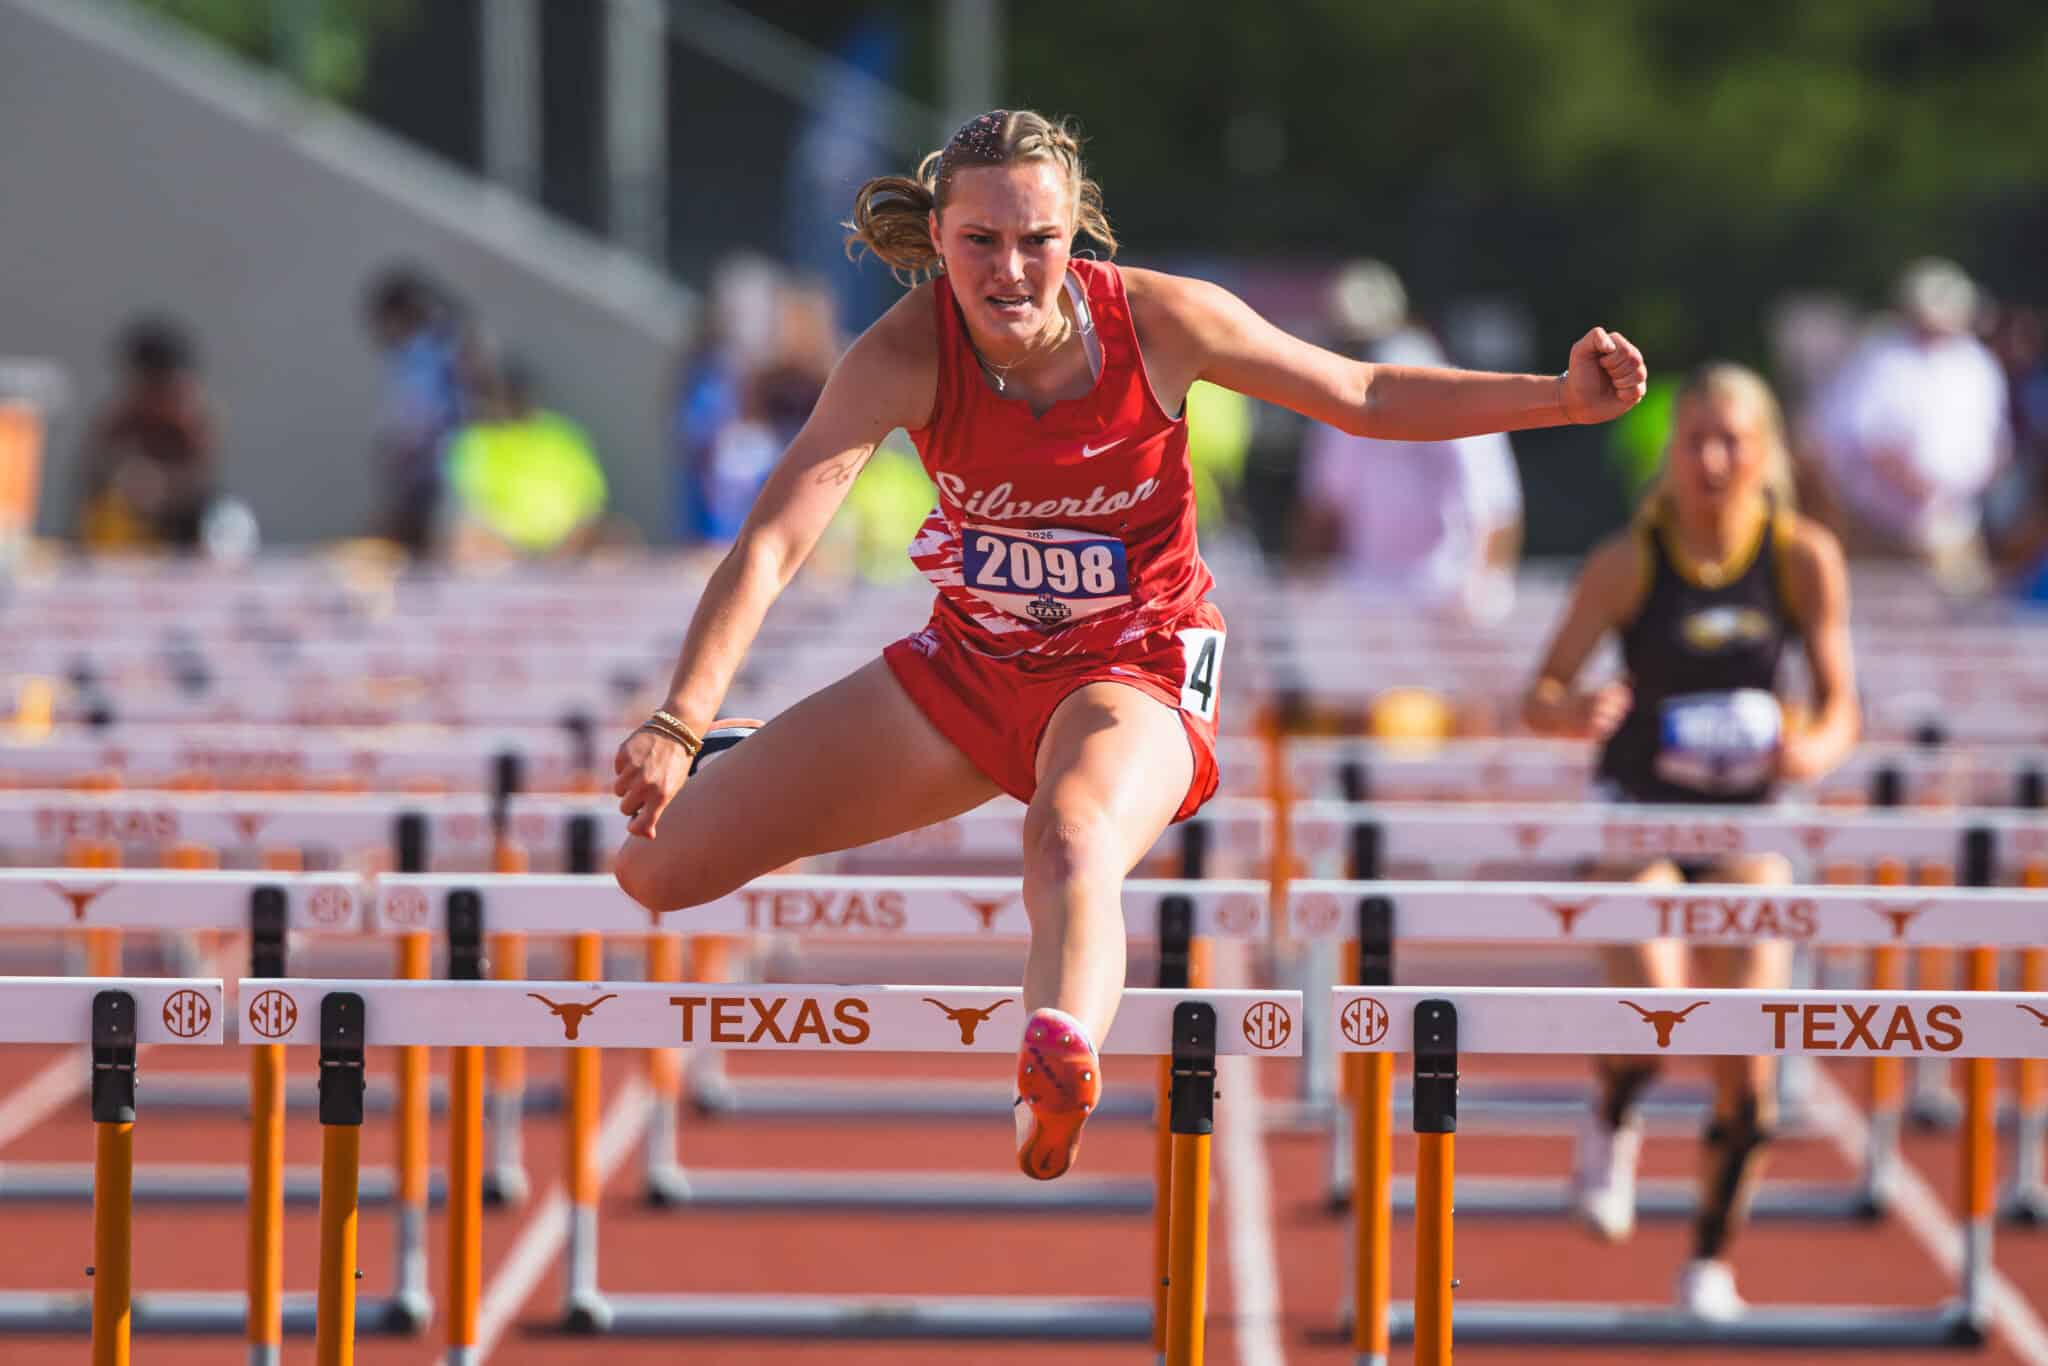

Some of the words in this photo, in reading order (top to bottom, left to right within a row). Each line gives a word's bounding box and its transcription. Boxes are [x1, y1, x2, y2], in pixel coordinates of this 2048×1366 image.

[936, 471, 1160, 520] Silverton
[976, 535, 1116, 594] 2098
[1189, 637, 1217, 713] 4
[741, 888, 907, 930] TEXAS
[1650, 898, 1819, 938] TEXAS
[163, 990, 211, 1037] SEC
[249, 990, 297, 1037] SEC
[671, 998, 870, 1045] TEXAS
[1243, 1001, 1291, 1049] SEC
[1341, 998, 1389, 1046] SEC
[1761, 1004, 1963, 1052] TEXAS
